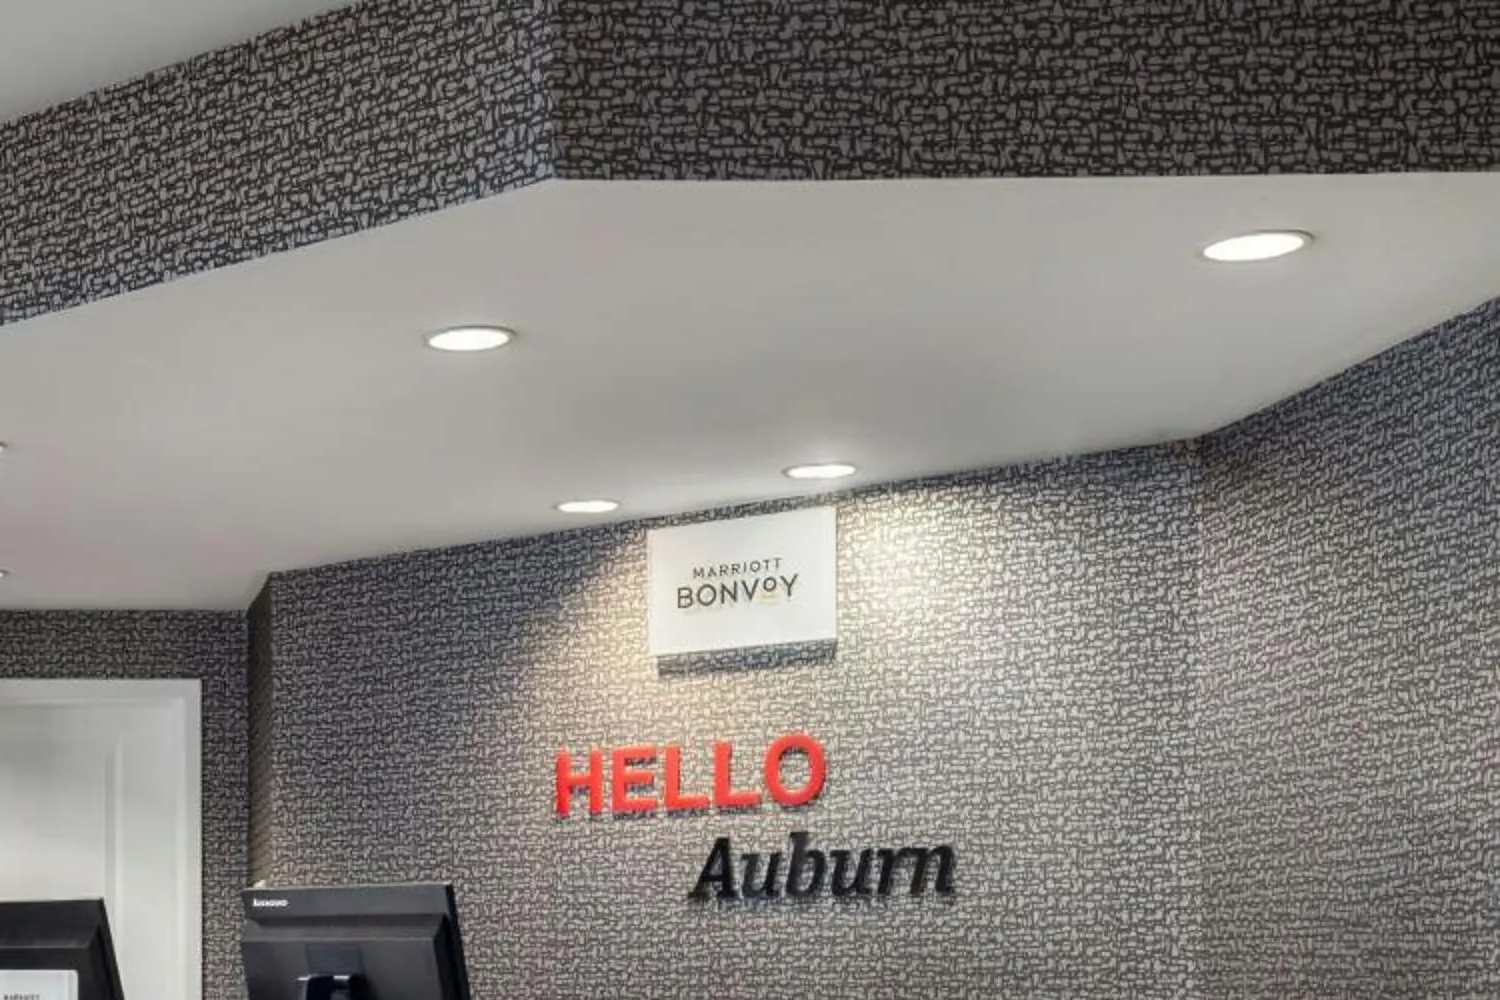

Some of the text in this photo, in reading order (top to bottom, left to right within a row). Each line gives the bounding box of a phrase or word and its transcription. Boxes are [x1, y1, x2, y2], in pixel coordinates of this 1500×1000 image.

[692, 557, 783, 579] MARRIOTT
[554, 731, 828, 817] HELLO
[687, 832, 958, 900] Auburn
